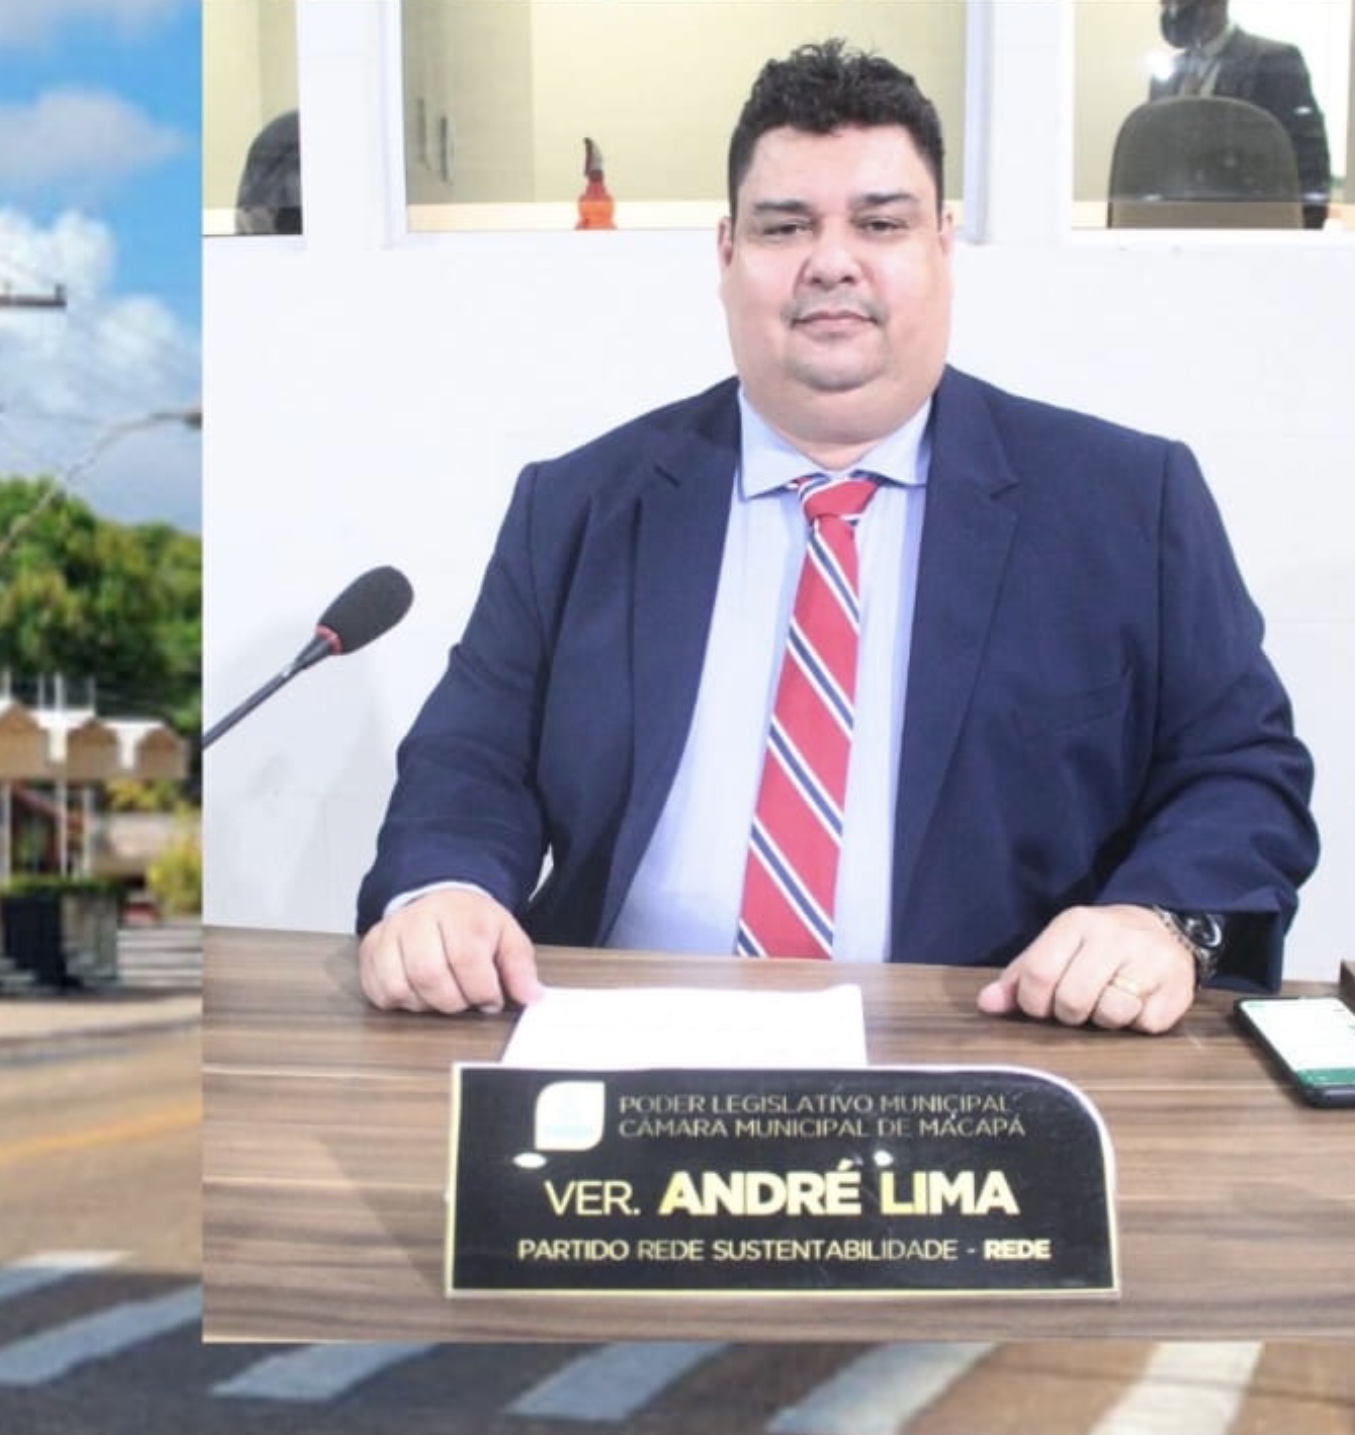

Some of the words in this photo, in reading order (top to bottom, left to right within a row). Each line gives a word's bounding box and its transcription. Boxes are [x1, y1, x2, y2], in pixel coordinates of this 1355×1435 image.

[619, 1094, 705, 1114] PODER
[711, 1093, 874, 1114] LEGISLATIVO
[879, 1093, 1010, 1114] MUNICIPAL
[735, 1117, 868, 1138] MUNICIPAL
[877, 1117, 912, 1138] DE
[919, 1113, 1026, 1138] MACAPÁ
[544, 1179, 642, 1217] VER.
[658, 1158, 862, 1216] ANDRÉ
[880, 1170, 1021, 1216] LIMA
[517, 1238, 630, 1262] PARTIDO
[637, 1239, 705, 1262] REDE
[711, 1239, 959, 1262] SUSTENTABILIDADE
[983, 1239, 1051, 1261] REDE
